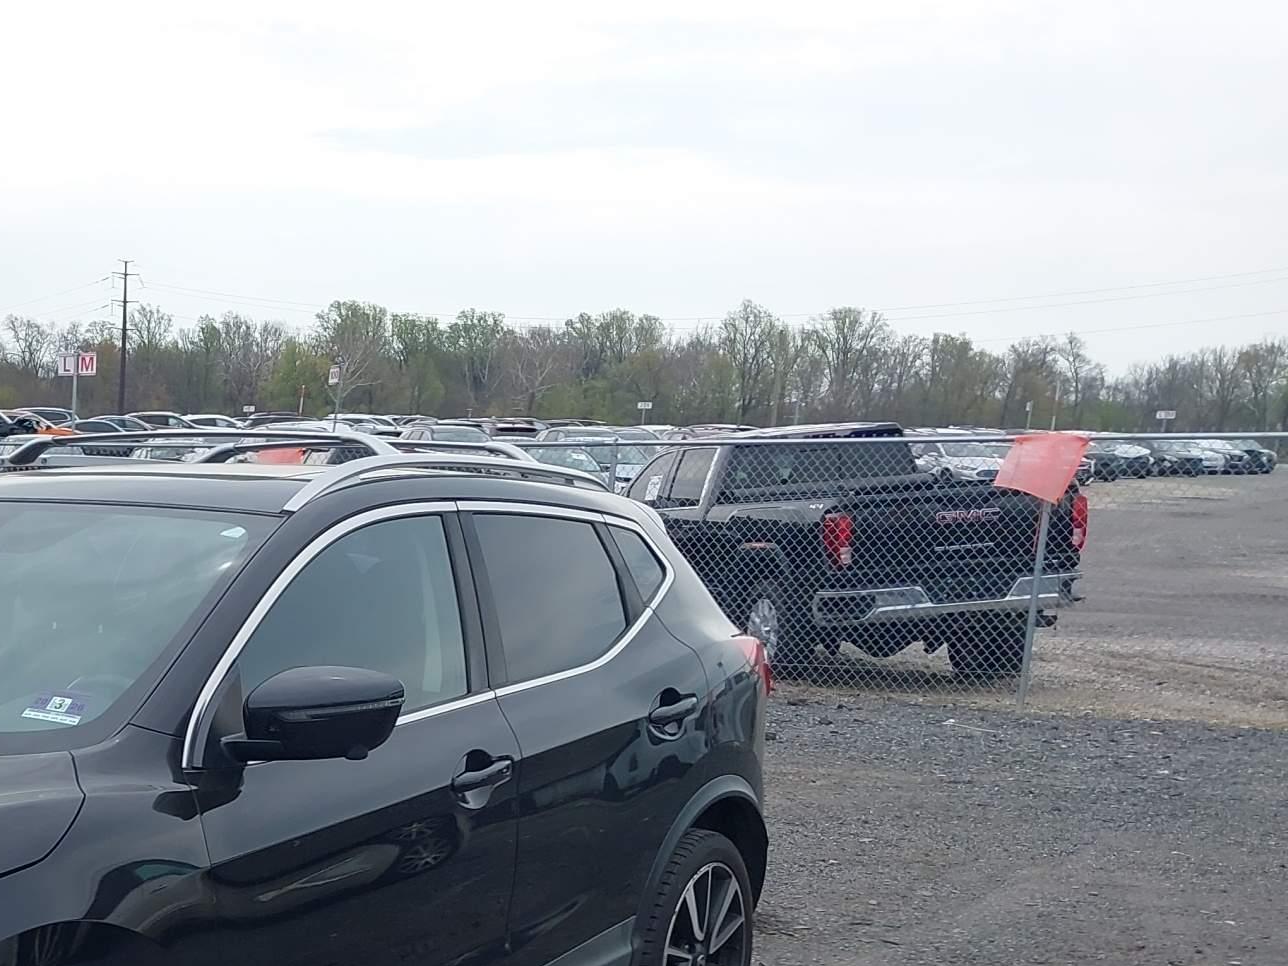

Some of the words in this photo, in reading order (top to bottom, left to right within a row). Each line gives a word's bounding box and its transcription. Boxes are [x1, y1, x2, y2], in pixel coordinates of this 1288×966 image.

[63, 356, 71, 372] L
[80, 356, 94, 372] M
[935, 507, 1001, 523] GMC
[54, 698, 66, 710] 3
